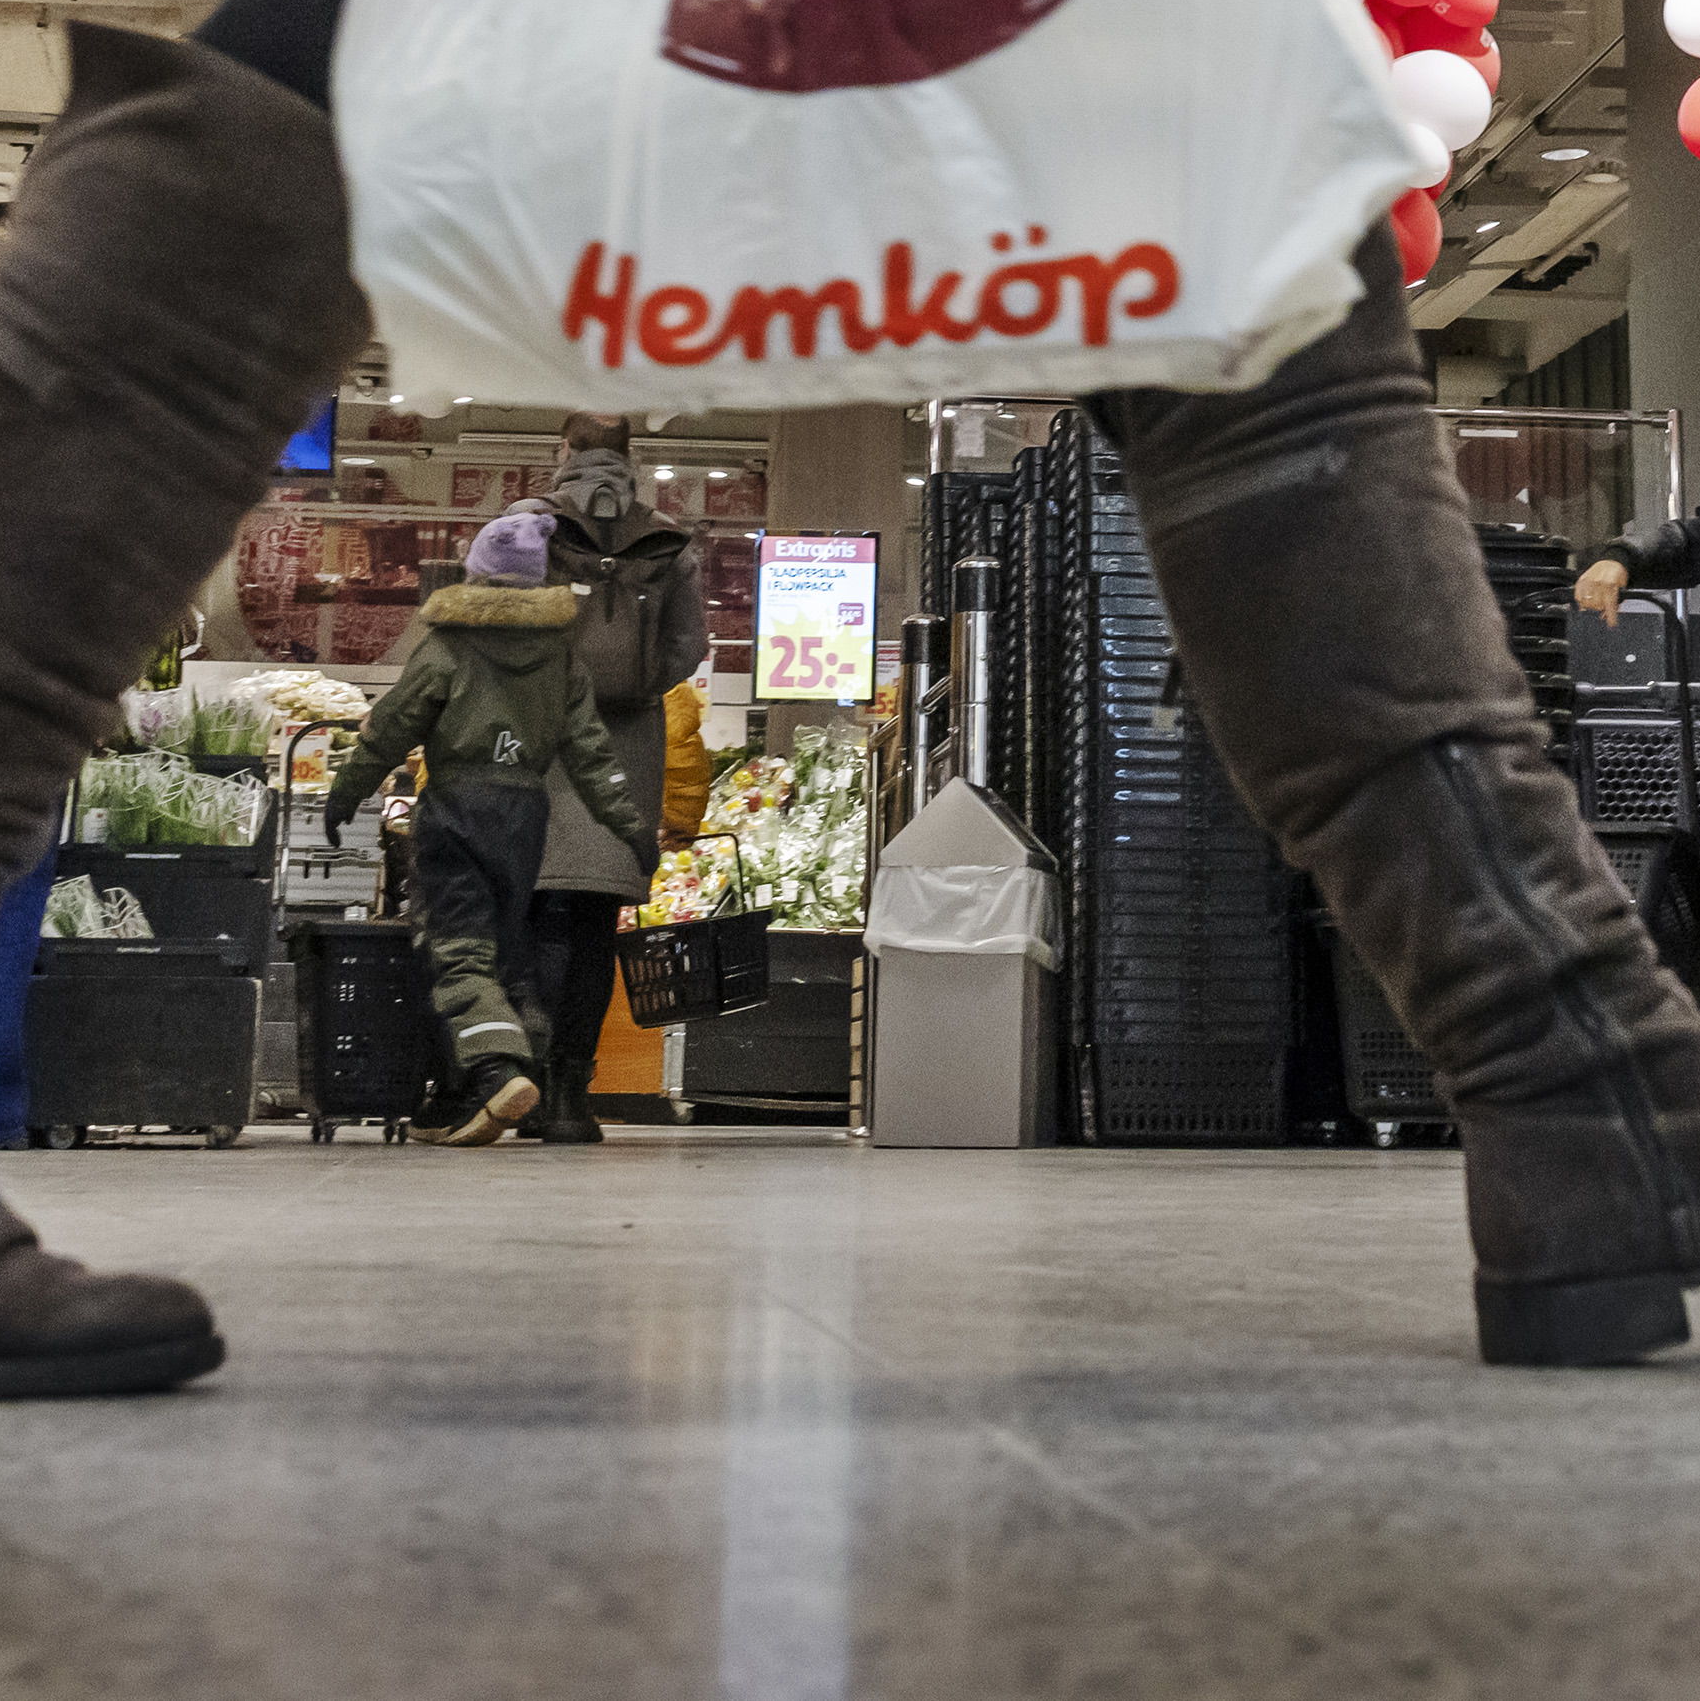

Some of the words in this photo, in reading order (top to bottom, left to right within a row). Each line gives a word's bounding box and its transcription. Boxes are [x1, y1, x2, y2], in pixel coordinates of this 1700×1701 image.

[562, 223, 1180, 369] Hemköp
[775, 540, 857, 562] Extrapris
[768, 635, 856, 689] 25:-
